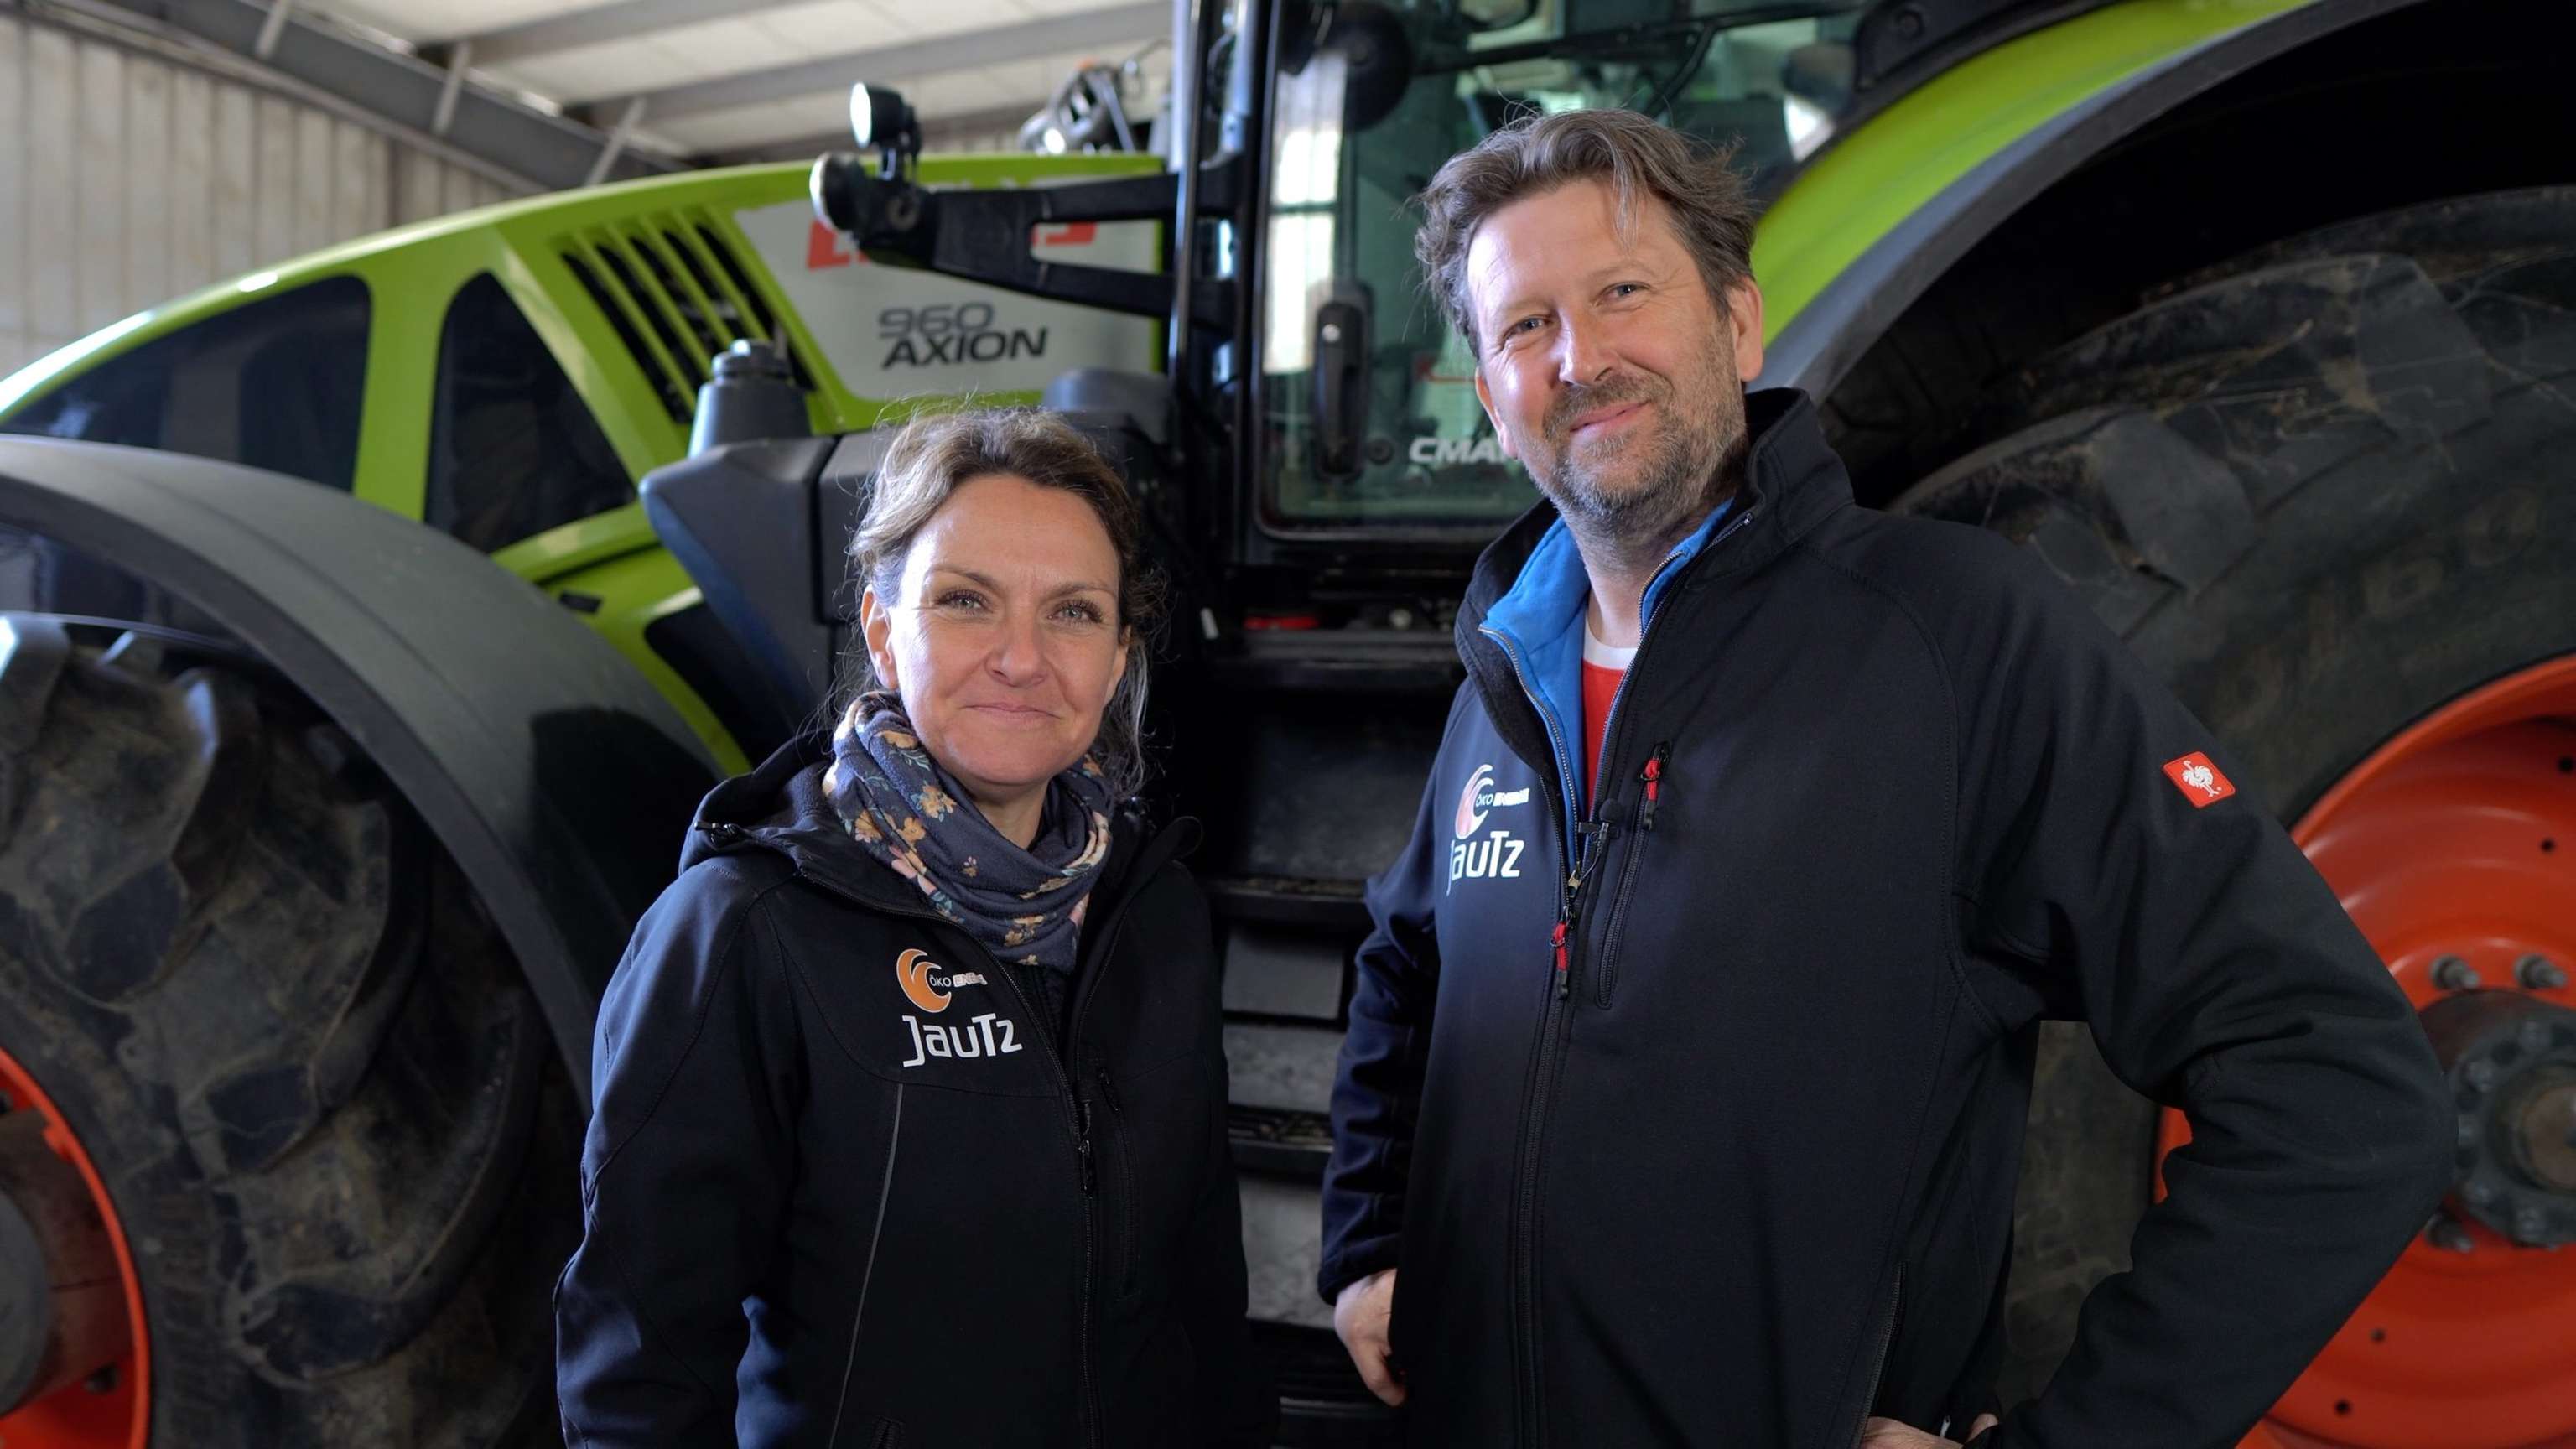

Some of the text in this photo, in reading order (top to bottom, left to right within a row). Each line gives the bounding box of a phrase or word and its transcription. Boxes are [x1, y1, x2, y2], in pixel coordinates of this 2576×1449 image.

[879, 302, 994, 337] 960
[882, 327, 1048, 369] AXION
[929, 974, 952, 988] ÖKO
